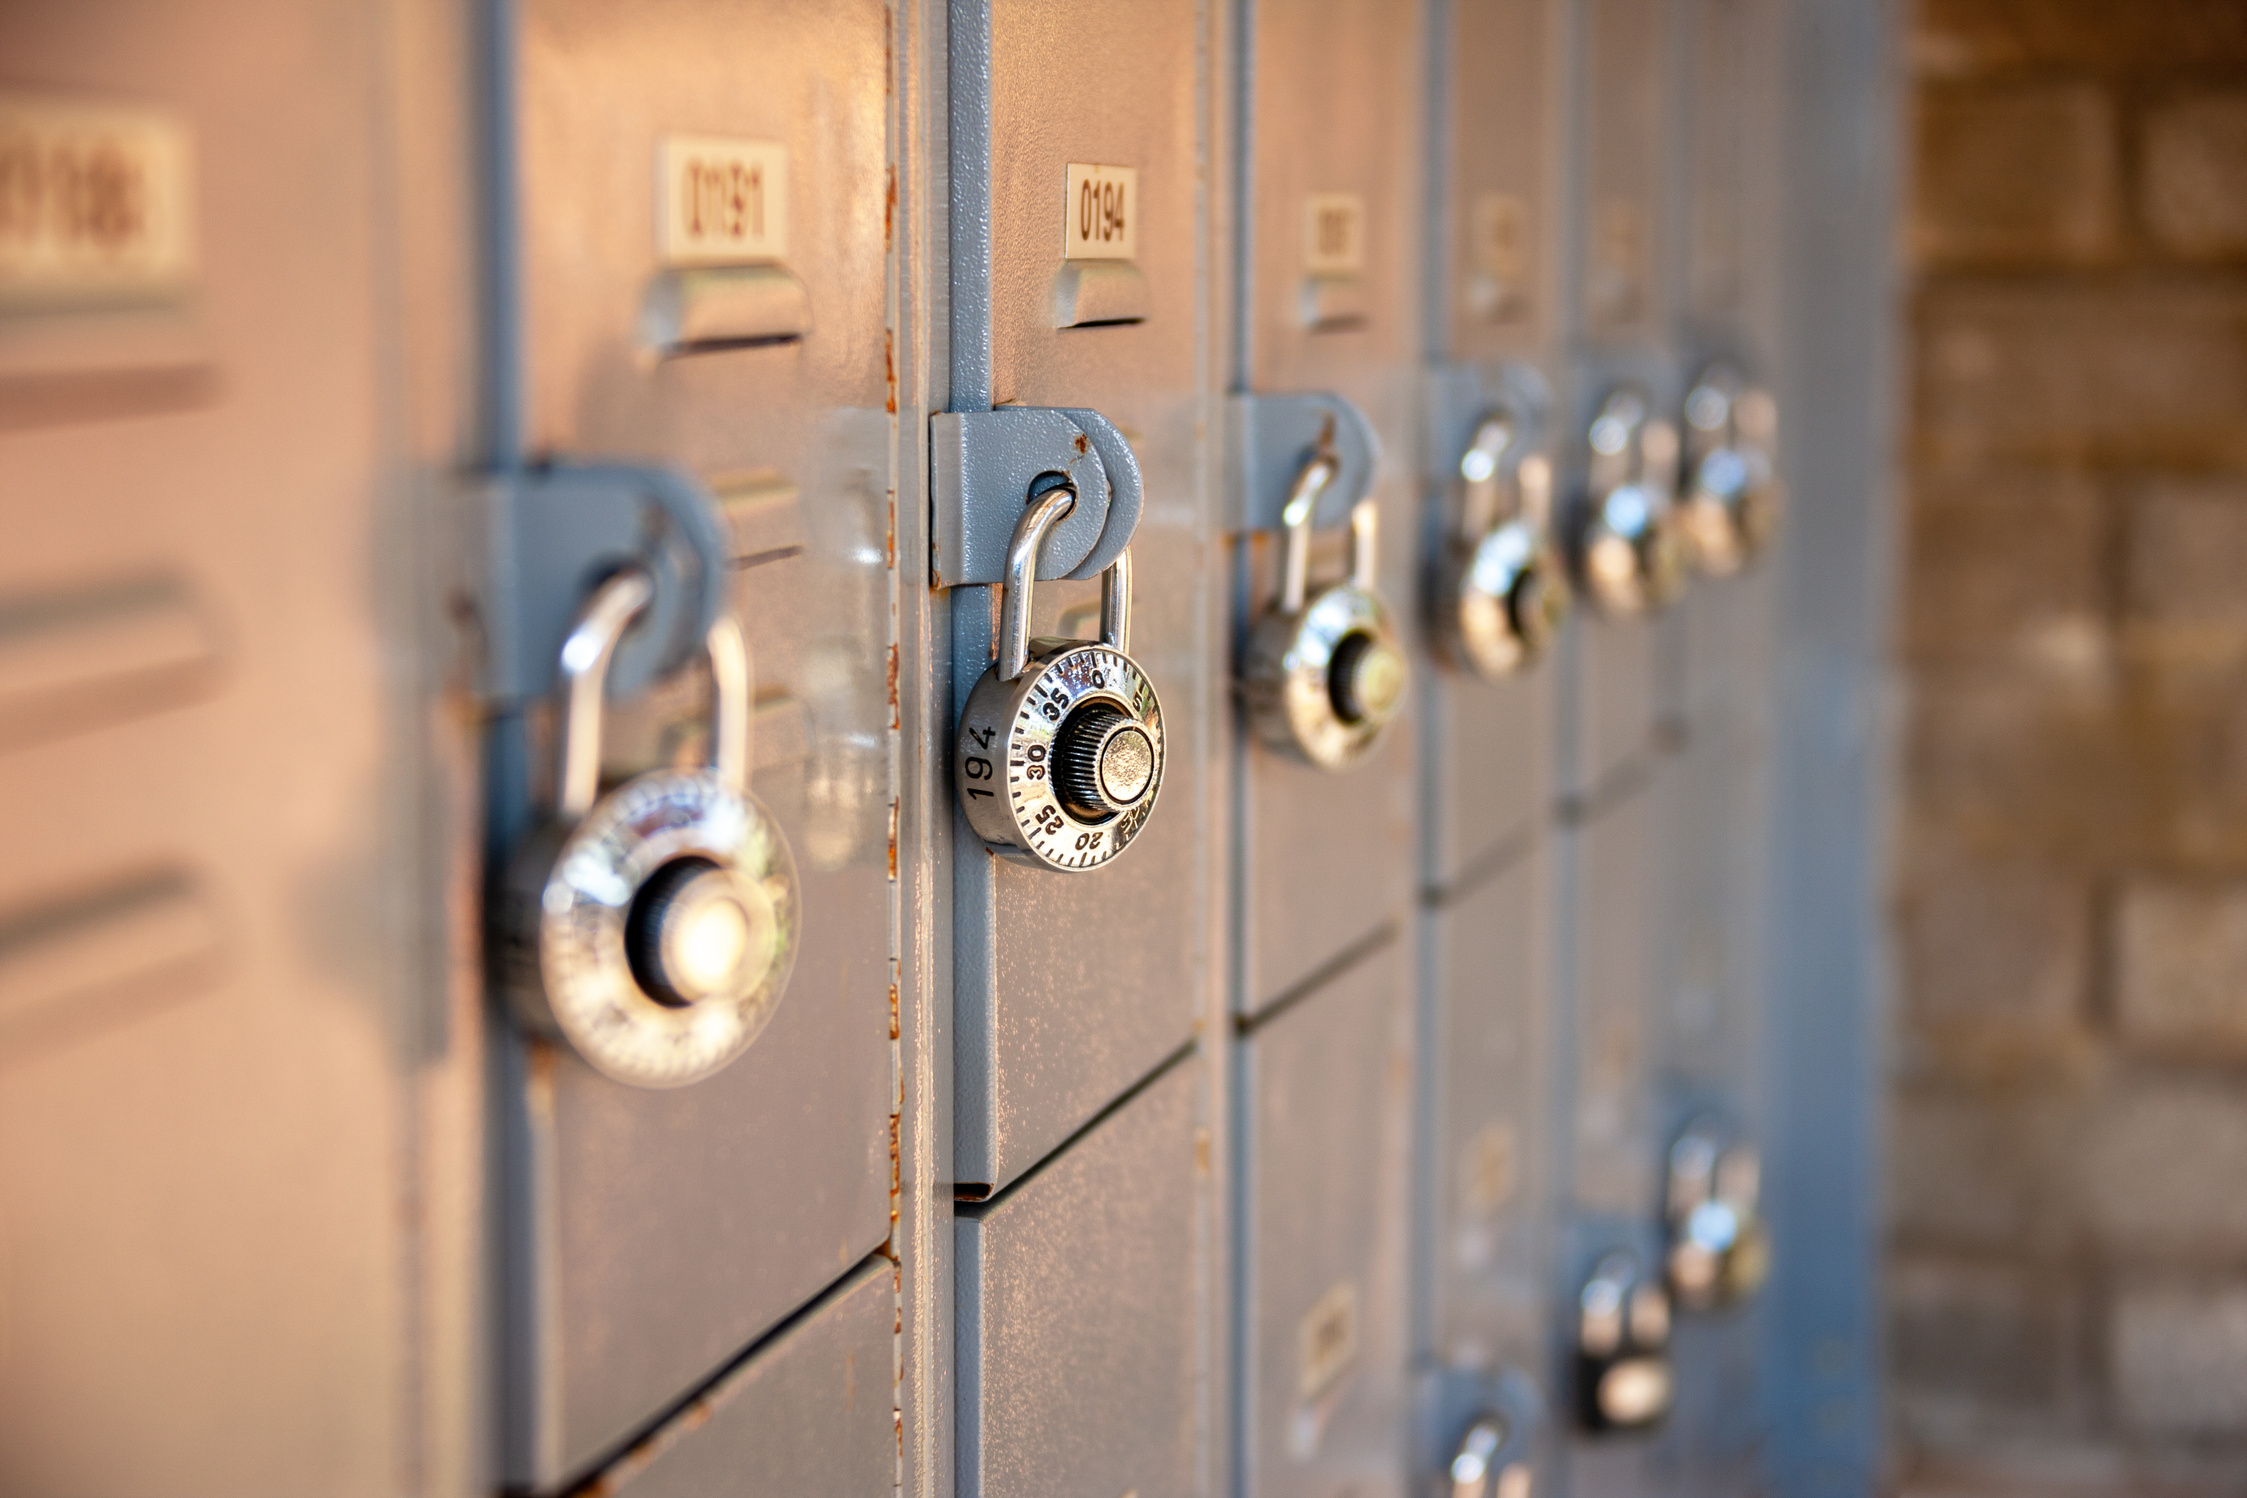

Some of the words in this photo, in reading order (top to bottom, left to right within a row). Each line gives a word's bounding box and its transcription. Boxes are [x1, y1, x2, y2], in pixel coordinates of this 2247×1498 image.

[682, 158, 765, 239] 0191
[1080, 179, 1125, 242] 0194
[1090, 669, 1106, 690] 0
[1042, 687, 1070, 722] 35
[964, 726, 997, 801] 194
[1026, 744, 1047, 781] 30
[1035, 804, 1065, 836] 25
[1074, 831, 1104, 851] 20
